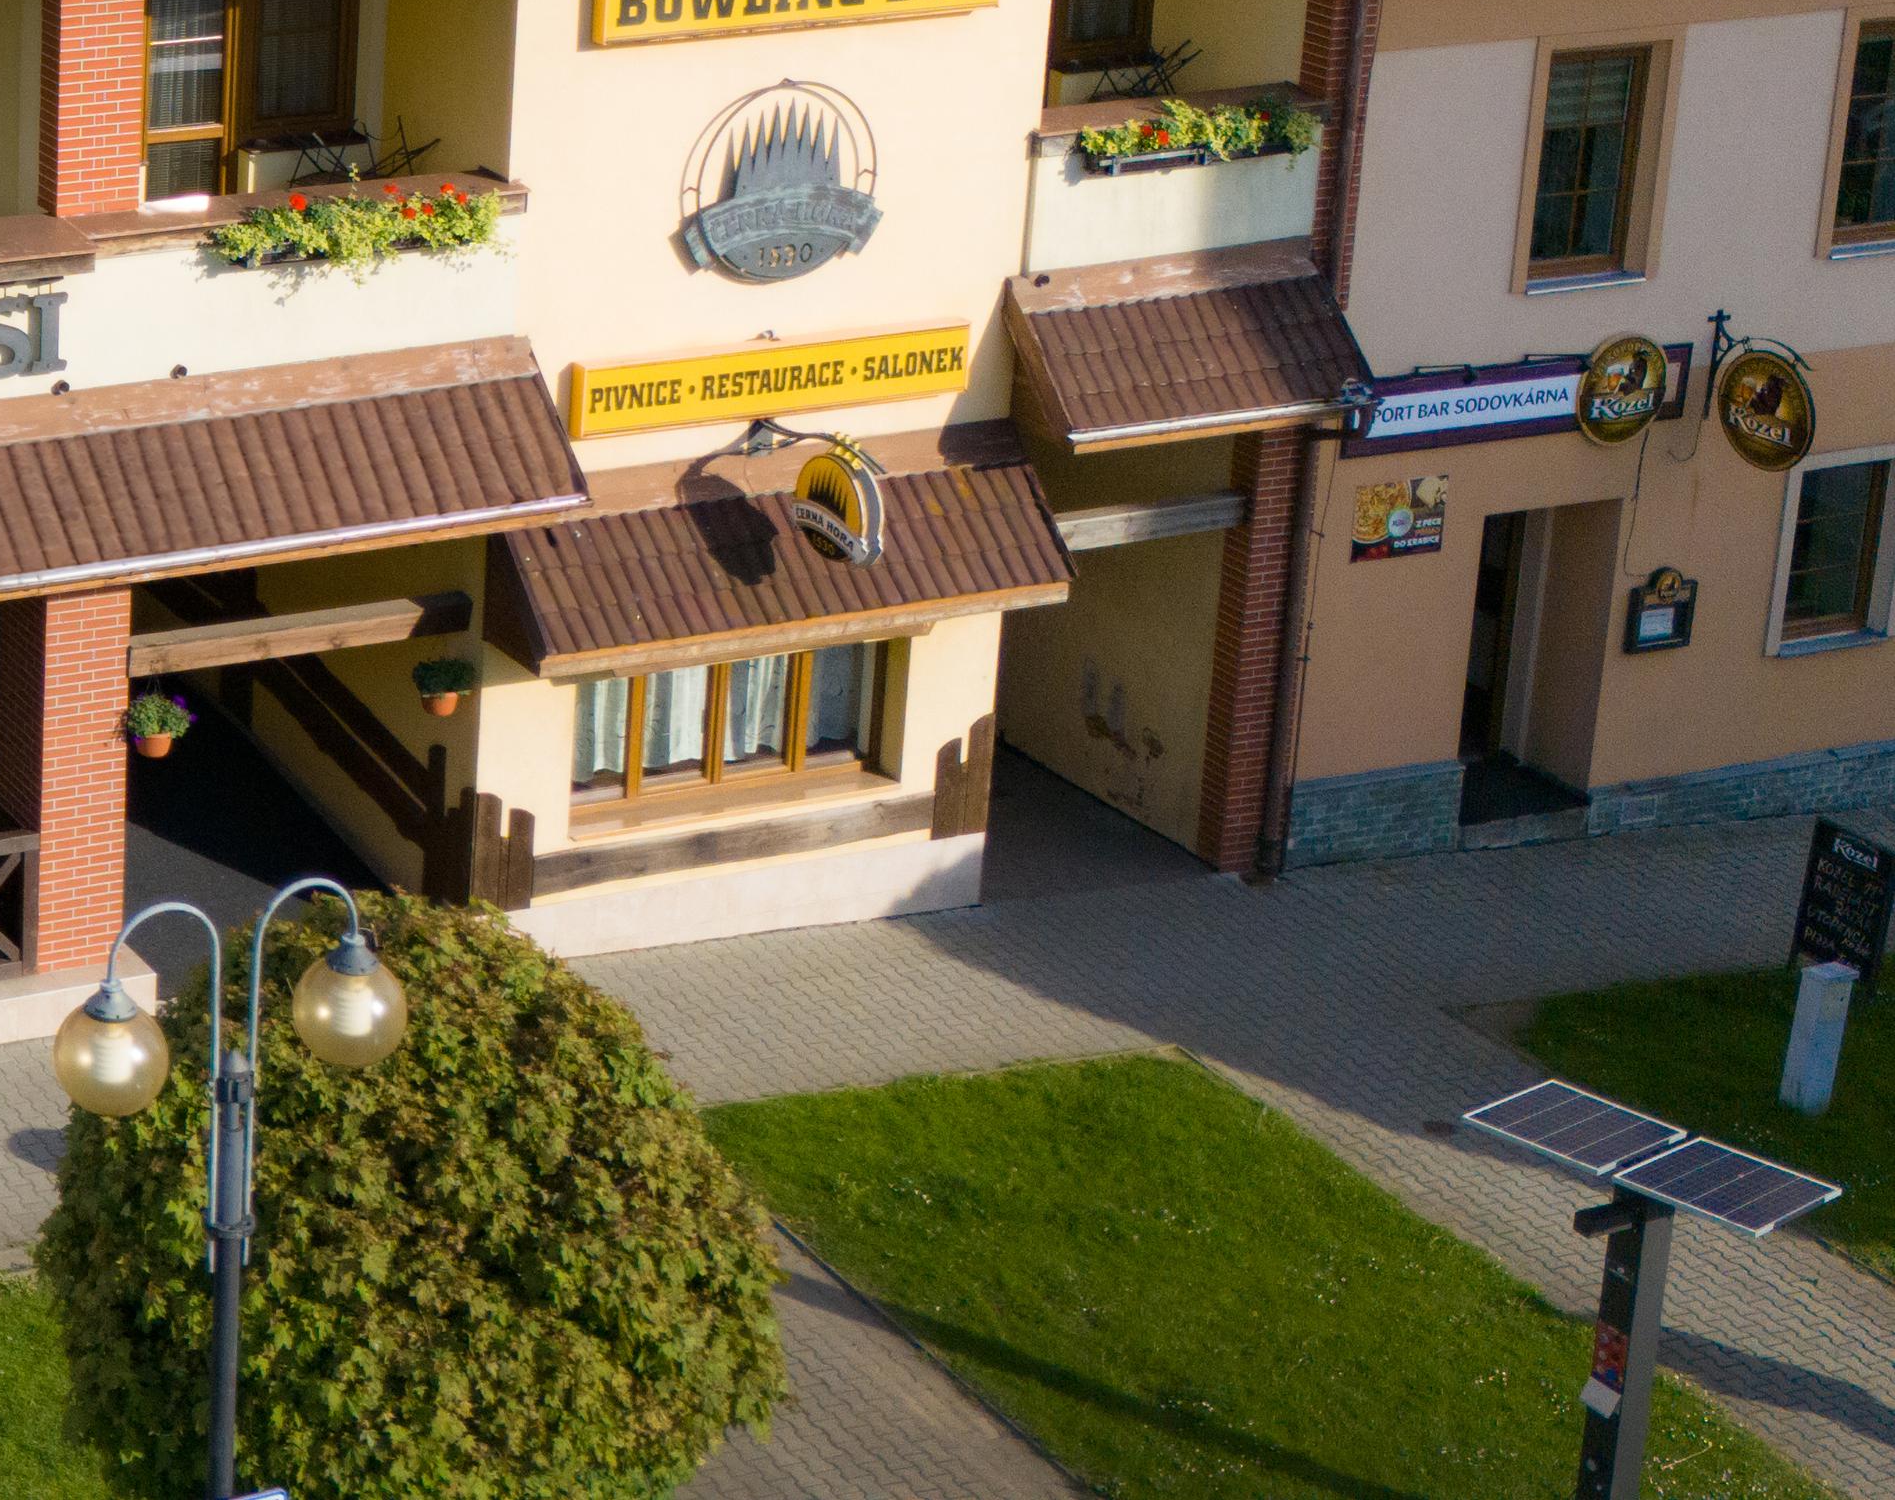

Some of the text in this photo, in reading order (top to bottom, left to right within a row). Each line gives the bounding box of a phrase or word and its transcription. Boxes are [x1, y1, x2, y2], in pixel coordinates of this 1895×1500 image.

[589, 346, 965, 414] PIVNICE RESTAURACE SALONEK
[1373, 387, 1569, 423] PORT BAR SODOVKÁRNA
[1590, 392, 1654, 420] Kozel
[1728, 403, 1794, 448] Kozel
[826, 520, 854, 551] HORA
[1833, 837, 1879, 872] Kozel
